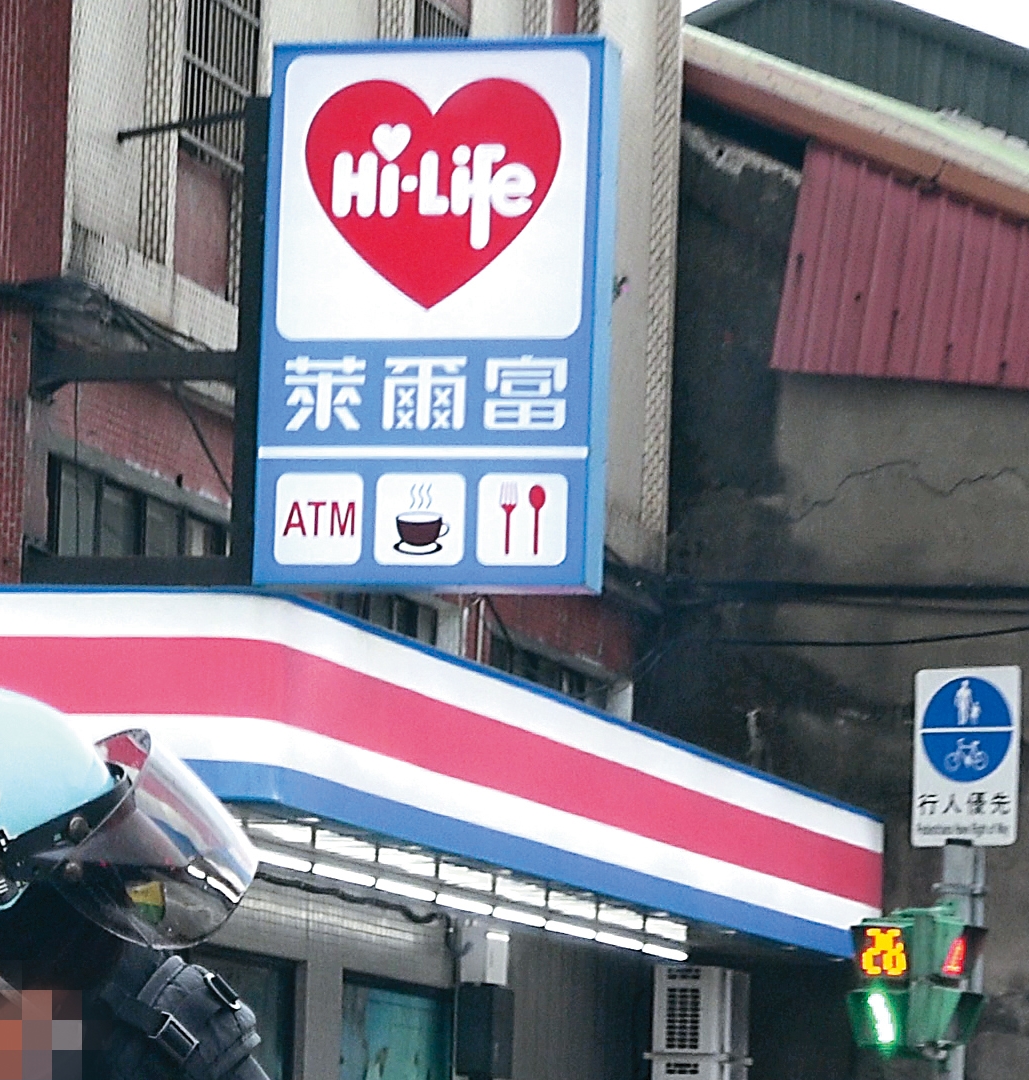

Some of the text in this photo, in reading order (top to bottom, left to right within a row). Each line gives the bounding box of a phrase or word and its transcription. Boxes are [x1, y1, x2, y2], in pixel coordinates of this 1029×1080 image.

[331, 124, 537, 250] Hi-Life
[284, 355, 569, 432] 萊爾富
[282, 501, 356, 537] ATM
[918, 791, 1011, 816] 行人優先
